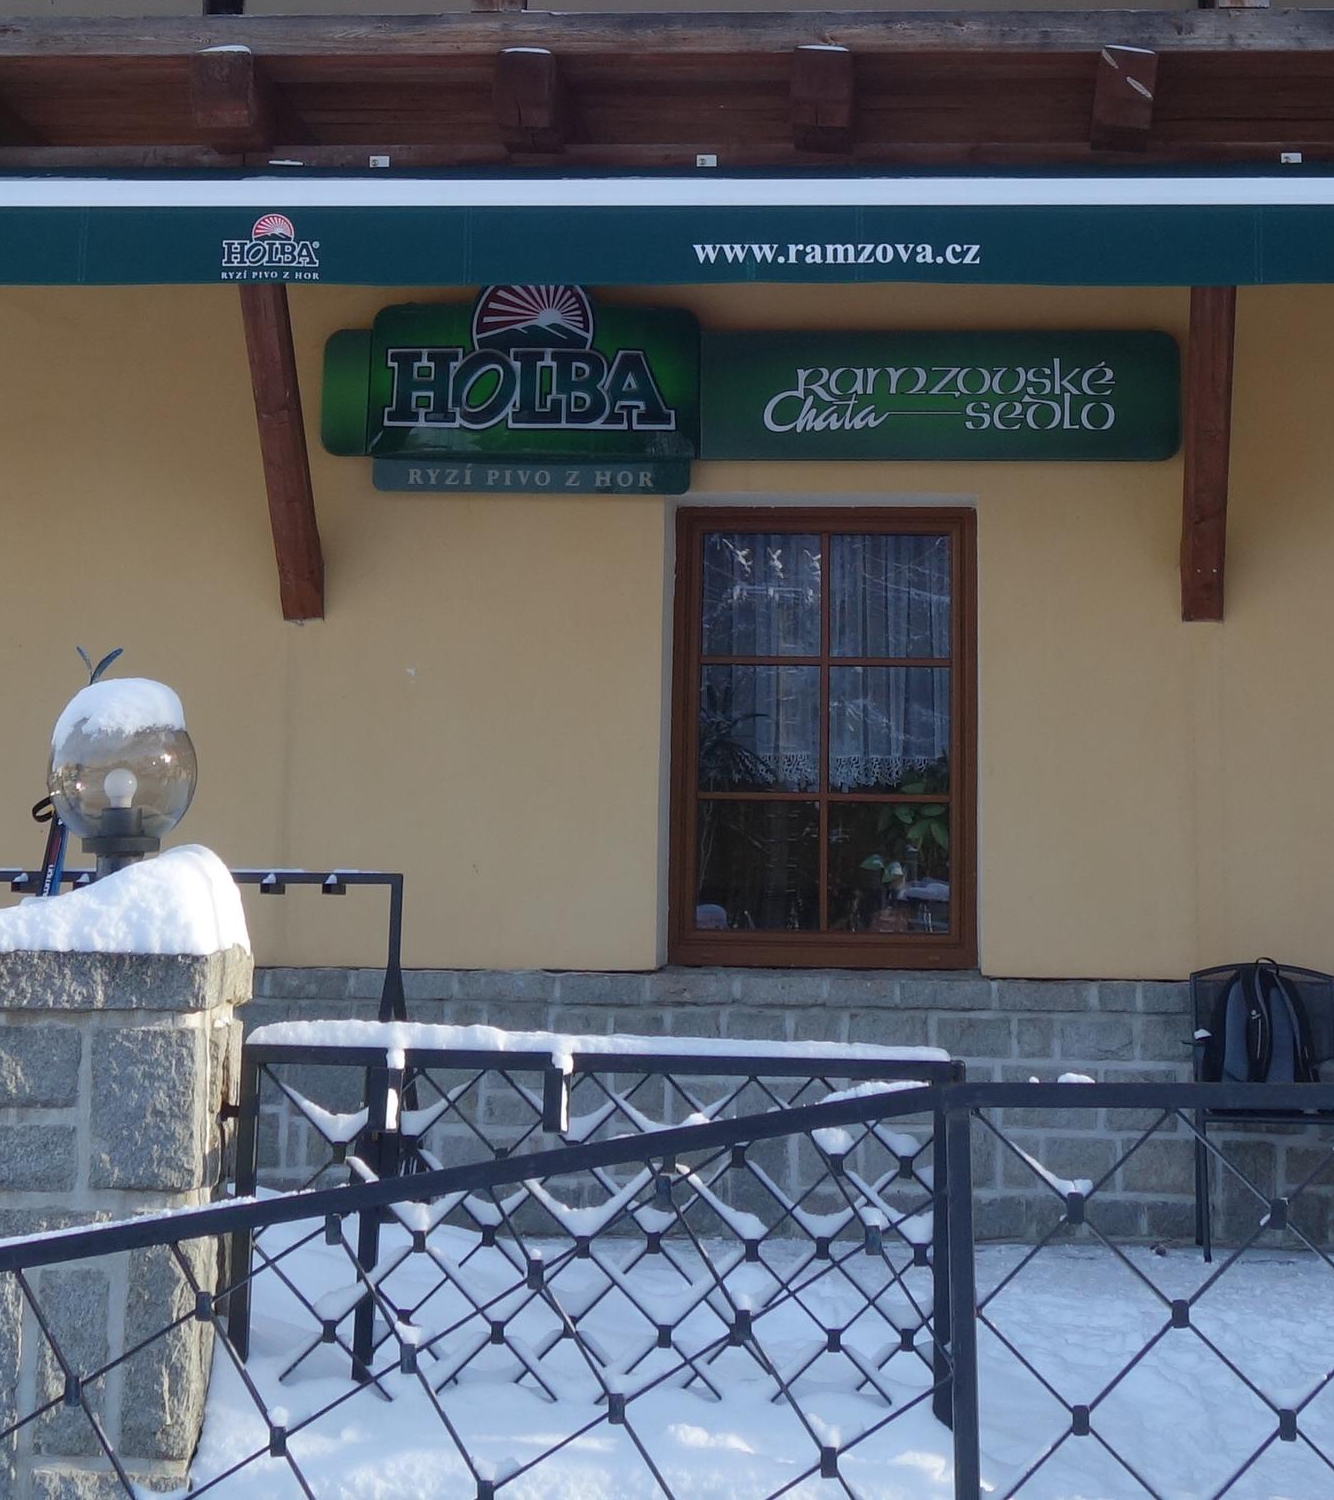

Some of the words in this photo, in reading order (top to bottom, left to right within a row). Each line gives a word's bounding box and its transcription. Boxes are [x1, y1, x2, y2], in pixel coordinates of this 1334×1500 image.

[222, 240, 319, 267] HOLBA
[692, 243, 981, 265] www.ramzova.cz
[221, 269, 247, 280] RYZÍ
[252, 271, 278, 280] PIVO
[283, 271, 290, 280] Z
[295, 272, 320, 280] HOR
[383, 347, 677, 431] HOLBA
[764, 390, 891, 433] Chata
[407, 463, 473, 486] RYZÍ
[487, 470, 552, 486] PIVO
[564, 471, 581, 487] Z
[594, 470, 655, 488] HOR
